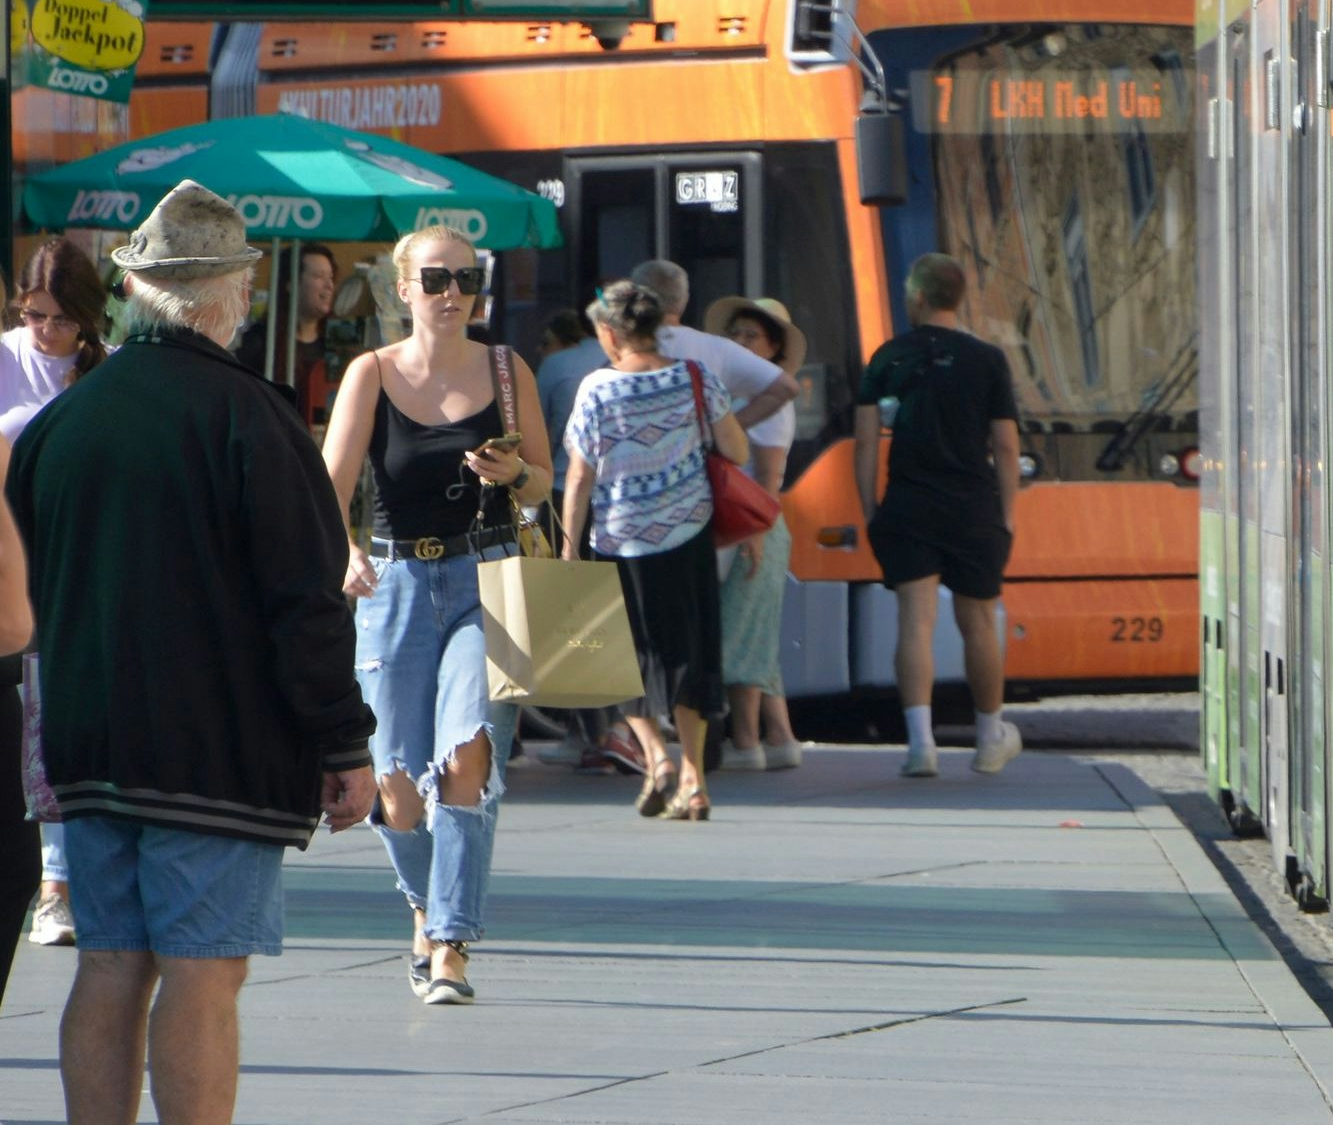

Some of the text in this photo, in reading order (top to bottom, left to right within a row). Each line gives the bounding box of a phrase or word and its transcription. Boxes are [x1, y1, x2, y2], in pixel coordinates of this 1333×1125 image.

[46, 18, 136, 55] Jackpot
[47, 66, 108, 95] LOTTO
[935, 76, 1161, 123] 7 LKH Med Uni
[67, 187, 141, 223] LOTTO
[1111, 617, 1165, 643] 229
